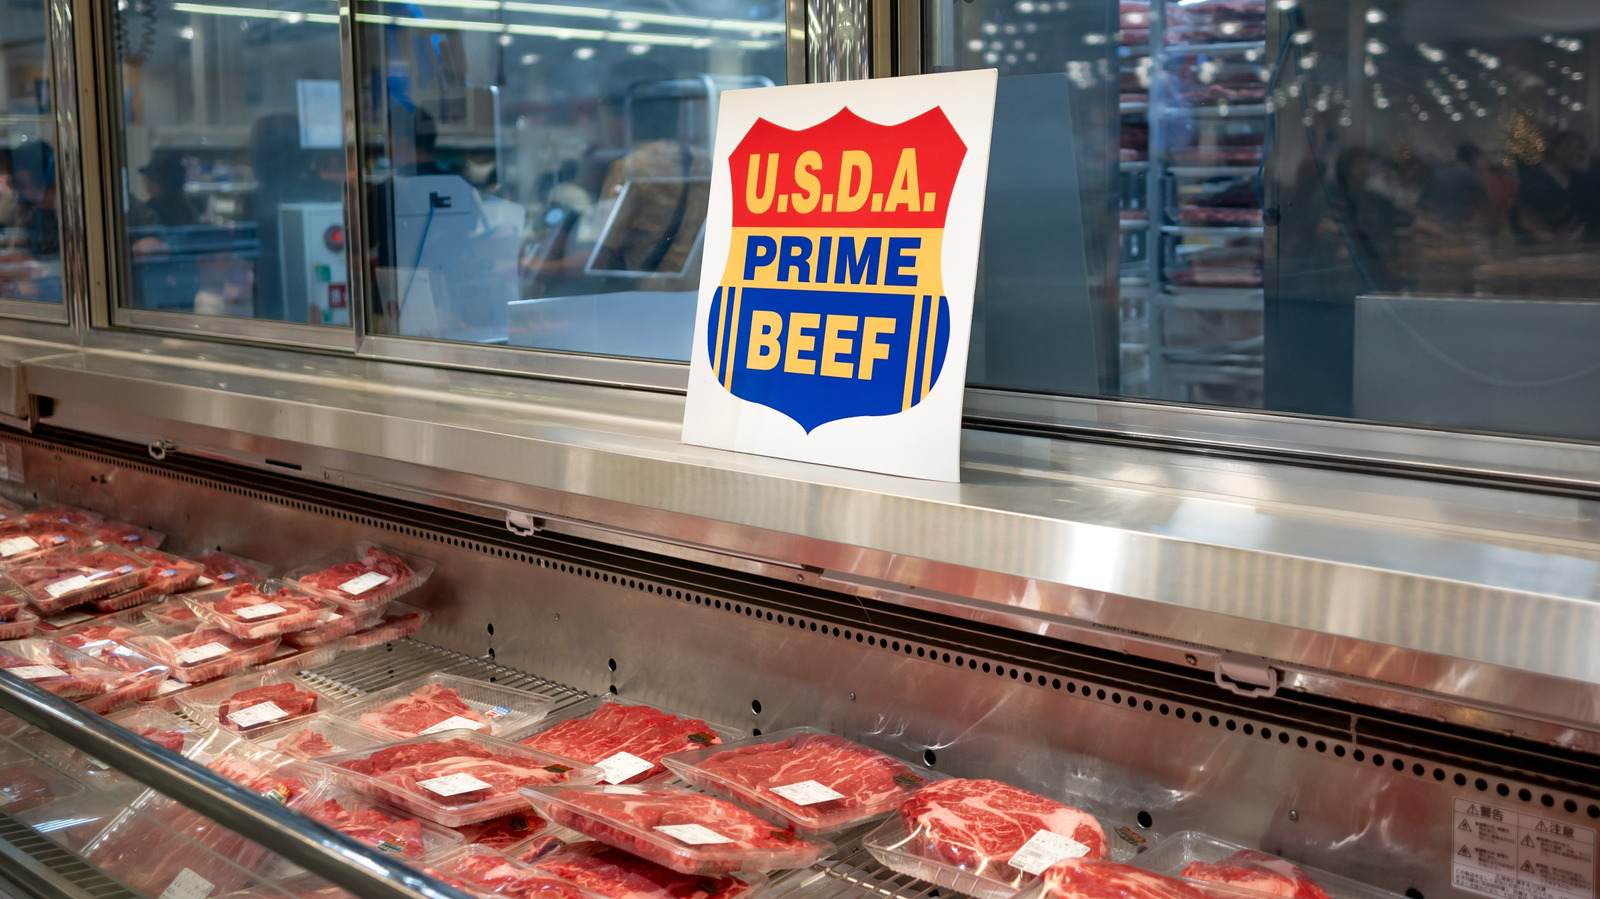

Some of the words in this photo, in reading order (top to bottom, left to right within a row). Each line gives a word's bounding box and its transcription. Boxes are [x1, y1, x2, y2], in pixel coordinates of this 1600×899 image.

[746, 148, 936, 214] U.S.D.A.
[743, 235, 922, 287] PRIME
[746, 310, 896, 380] BEEF
[1481, 806, 1503, 821] 警告
[1550, 823, 1574, 839] 注意
